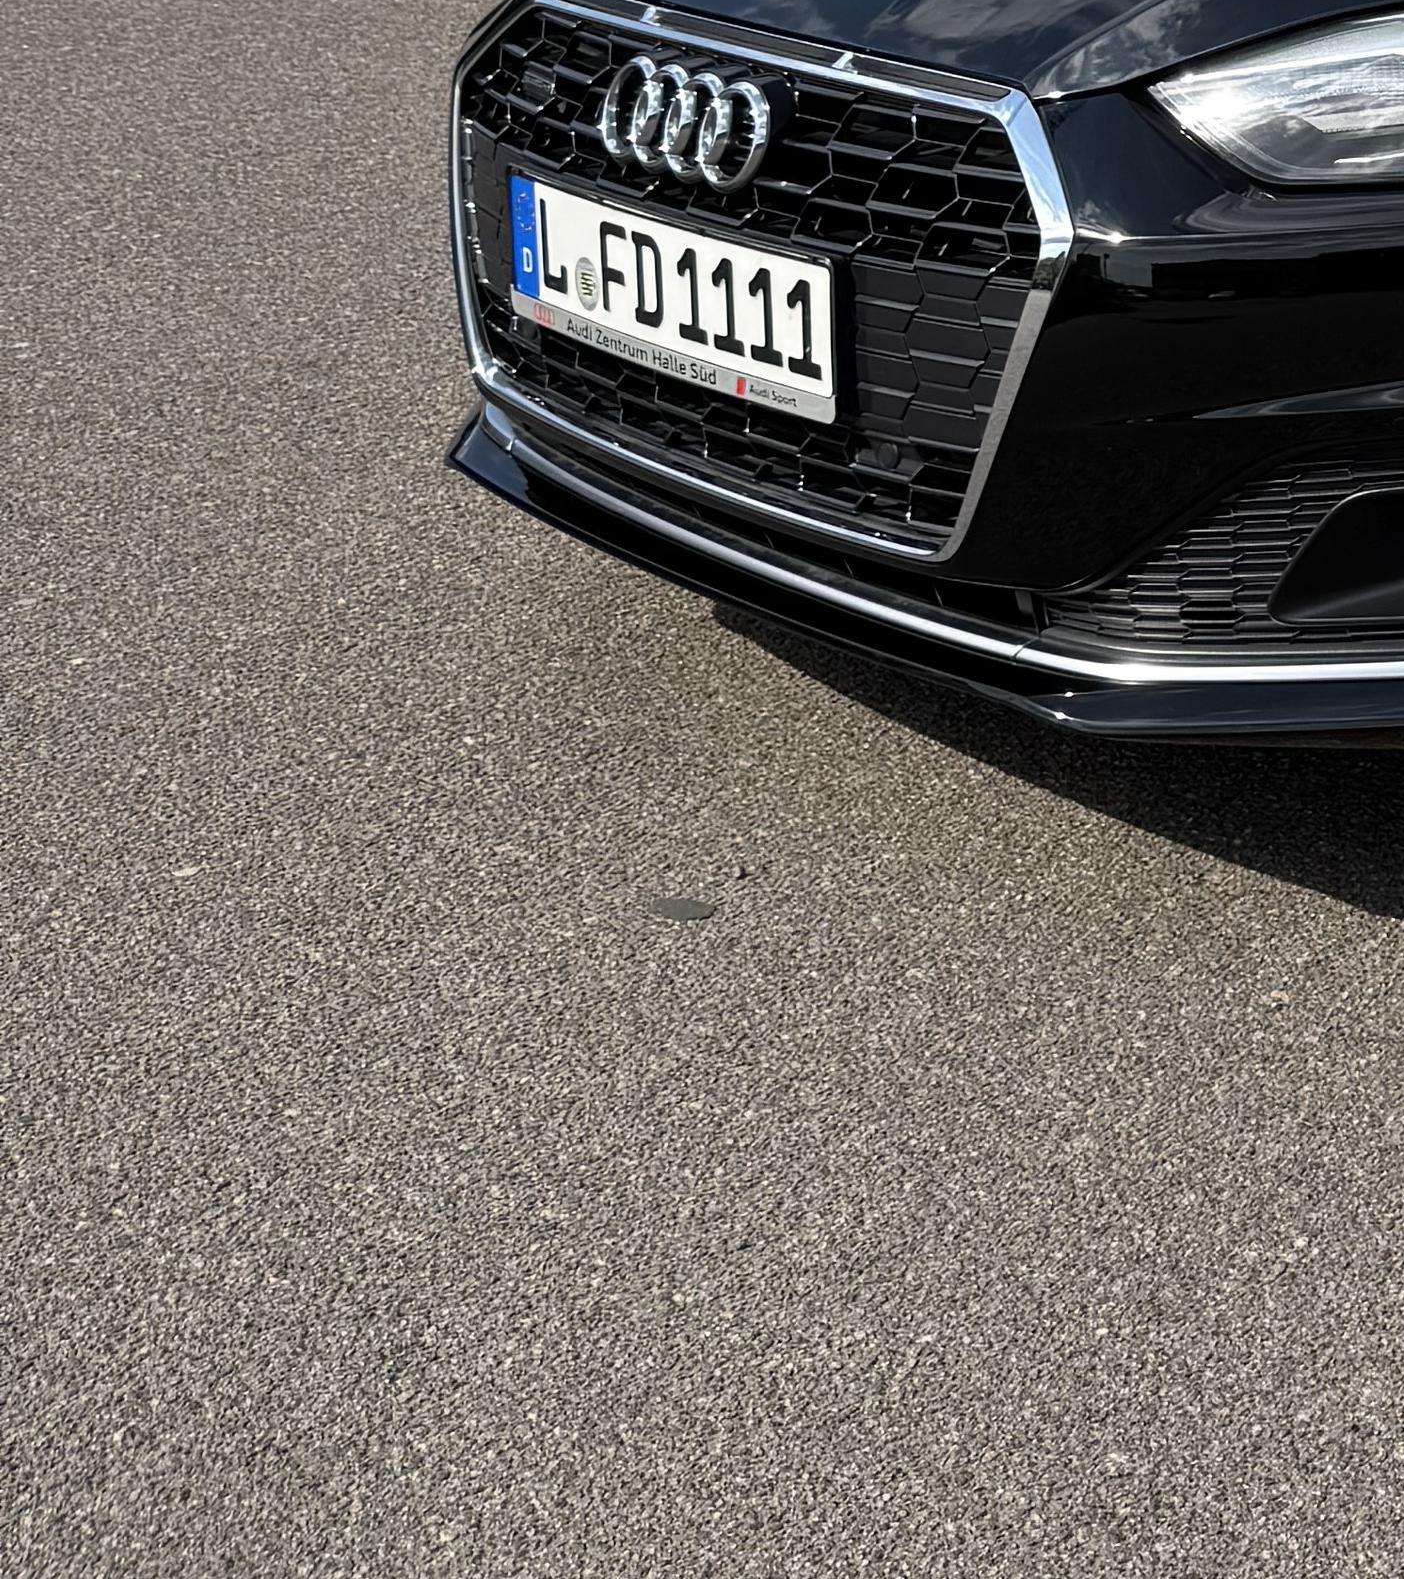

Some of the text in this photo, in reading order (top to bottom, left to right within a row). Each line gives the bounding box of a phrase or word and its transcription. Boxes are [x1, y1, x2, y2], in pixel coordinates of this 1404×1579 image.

[522, 246, 533, 273] D
[539, 197, 568, 295] L
[567, 318, 717, 385] Audi Zentrum Halle Süd
